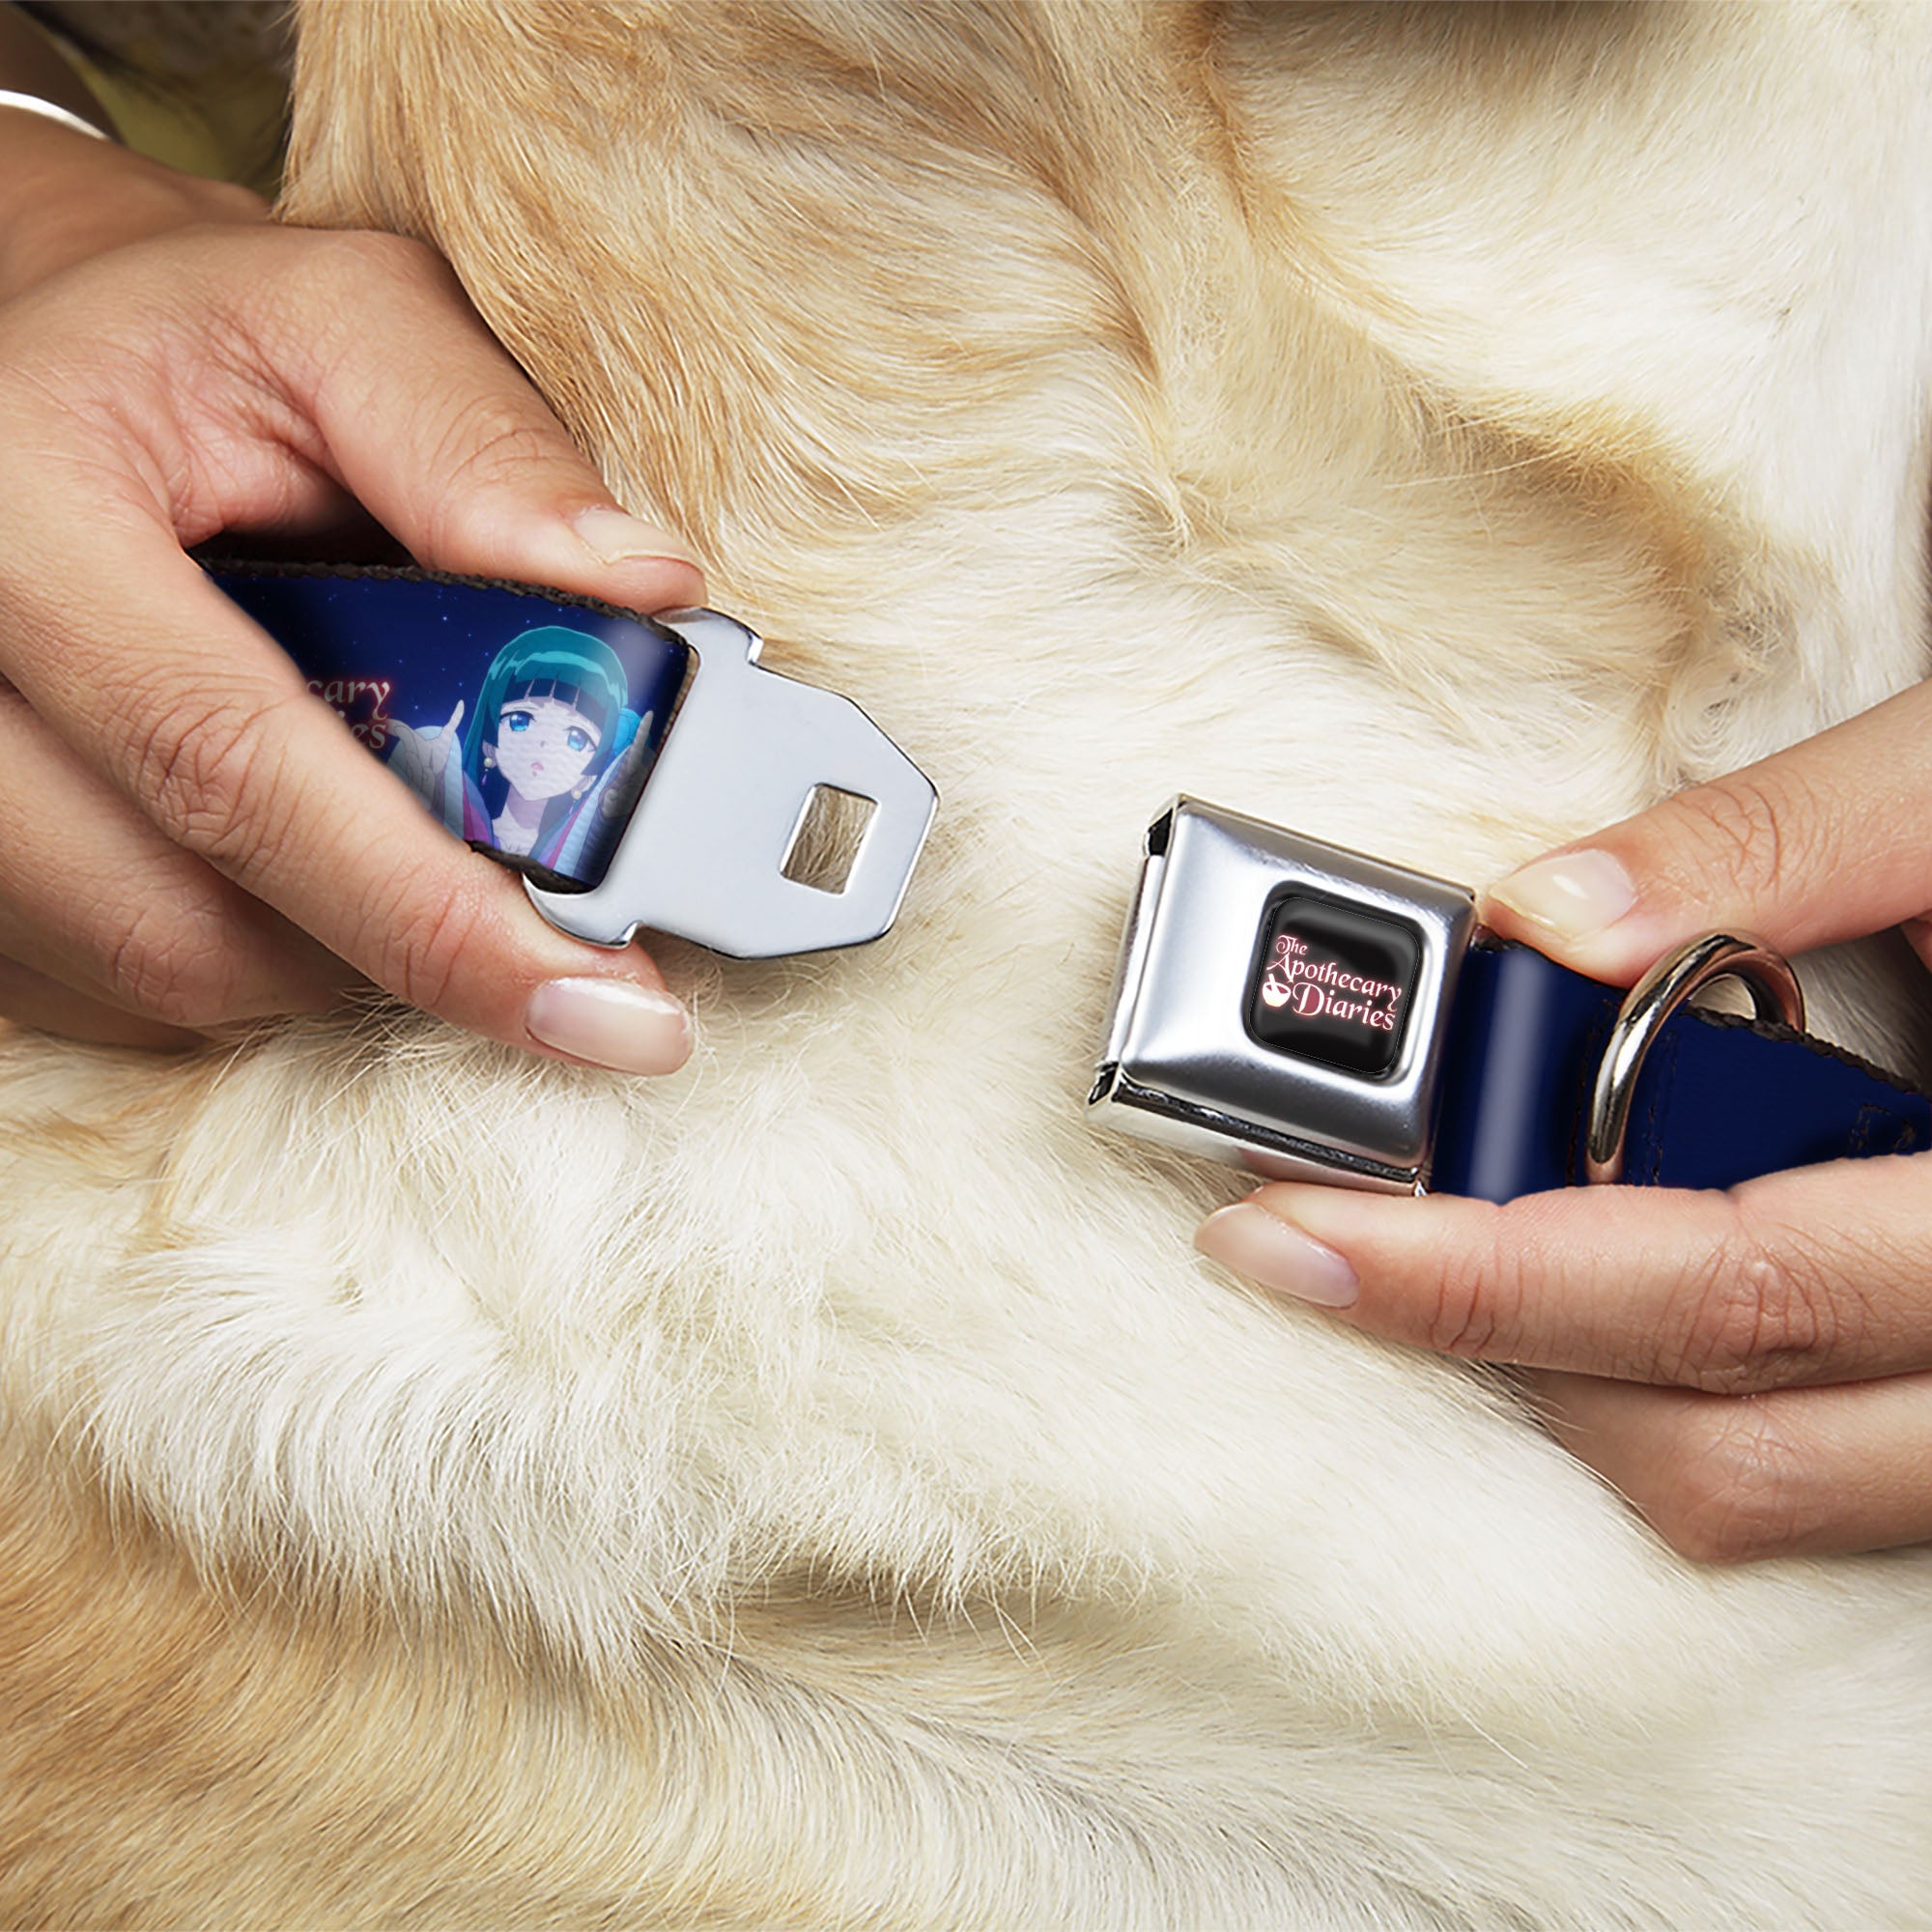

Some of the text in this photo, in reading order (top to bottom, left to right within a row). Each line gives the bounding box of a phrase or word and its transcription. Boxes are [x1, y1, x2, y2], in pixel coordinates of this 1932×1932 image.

[1275, 934, 1308, 955] The
[1266, 952, 1402, 1012] Apothecary
[1293, 981, 1396, 1031] Diaries
